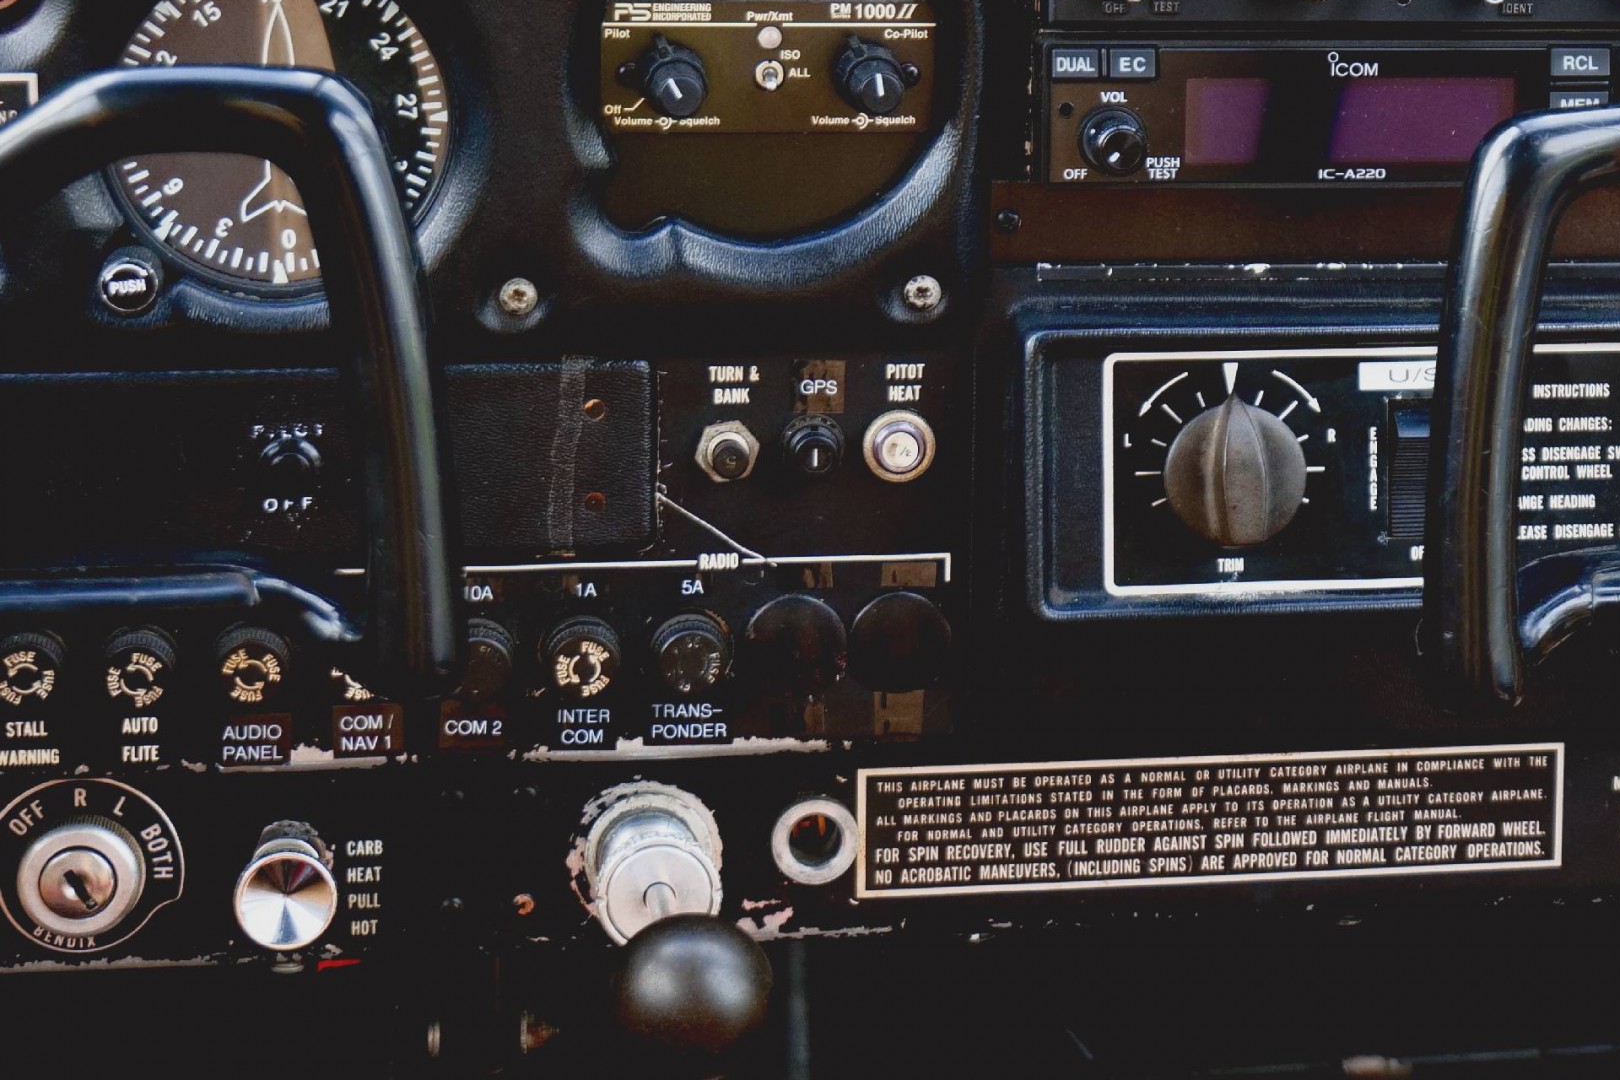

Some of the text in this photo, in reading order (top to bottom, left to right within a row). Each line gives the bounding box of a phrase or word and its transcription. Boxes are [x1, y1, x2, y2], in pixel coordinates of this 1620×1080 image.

[653, 3, 711, 12] ENGINEERING
[855, 4, 895, 19] 1000
[653, 13, 711, 21] INCORPORATED
[746, 11, 793, 23] Pwr/Xmt
[605, 28, 630, 39] Pilot
[885, 28, 928, 39] Co-Pilot
[369, 31, 398, 61] 24
[780, 49, 801, 60] ISO
[1056, 57, 1095, 71] DUAL
[1563, 56, 1598, 70] RCL
[788, 68, 811, 78] ALL
[1101, 92, 1127, 102] VOL
[812, 115, 849, 125] Volume
[875, 114, 915, 126] Squelch
[1147, 158, 1180, 168] PUSH
[1064, 169, 1087, 179] OFF
[1150, 169, 1178, 179] TEST
[1318, 169, 1385, 179] IC-A220
[108, 279, 146, 296] PUSH
[708, 365, 742, 382] TURN
[886, 364, 924, 380] PITOT
[800, 379, 837, 395] GPS
[889, 385, 922, 401] HEAT
[1533, 383, 1609, 398] INSTRUCTIONS
[714, 387, 750, 404] BANK
[1559, 418, 1612, 431] CHANGES:
[1542, 447, 1601, 460] DISENGAGE
[1577, 465, 1612, 478] WHEEL
[1550, 495, 1595, 508] HEADING
[699, 553, 738, 569] RADIO
[1218, 558, 1244, 571] TRIM
[576, 583, 596, 598] 1A
[682, 580, 703, 595] 5A
[557, 709, 610, 724] INTER
[652, 704, 722, 718] TRANS-
[6, 722, 48, 737] STALL
[123, 718, 157, 733] AUTO
[223, 725, 282, 740] AUDIO
[445, 721, 502, 735] COM 2
[652, 723, 727, 739] PONDER
[561, 729, 604, 744] COM
[123, 746, 159, 761] FLITE
[223, 745, 282, 760] PANEL
[1035, 759, 1484, 787] OPERATED COMPLIANCE
[9, 799, 45, 836] OFF
[1024, 823, 1495, 857] USE FULL RUDDER AGAINST SPIN FOLLOWED IMMEDIATELY FORWARD
[140, 823, 174, 880] BOTH
[347, 841, 383, 856] CARB
[901, 841, 1545, 883] ACROBATIC APPROVED NORMAL CATEGORY OPERATIONS.
[347, 867, 381, 883] HEAT
[348, 893, 380, 908] PULL
[351, 920, 378, 935] HOT
